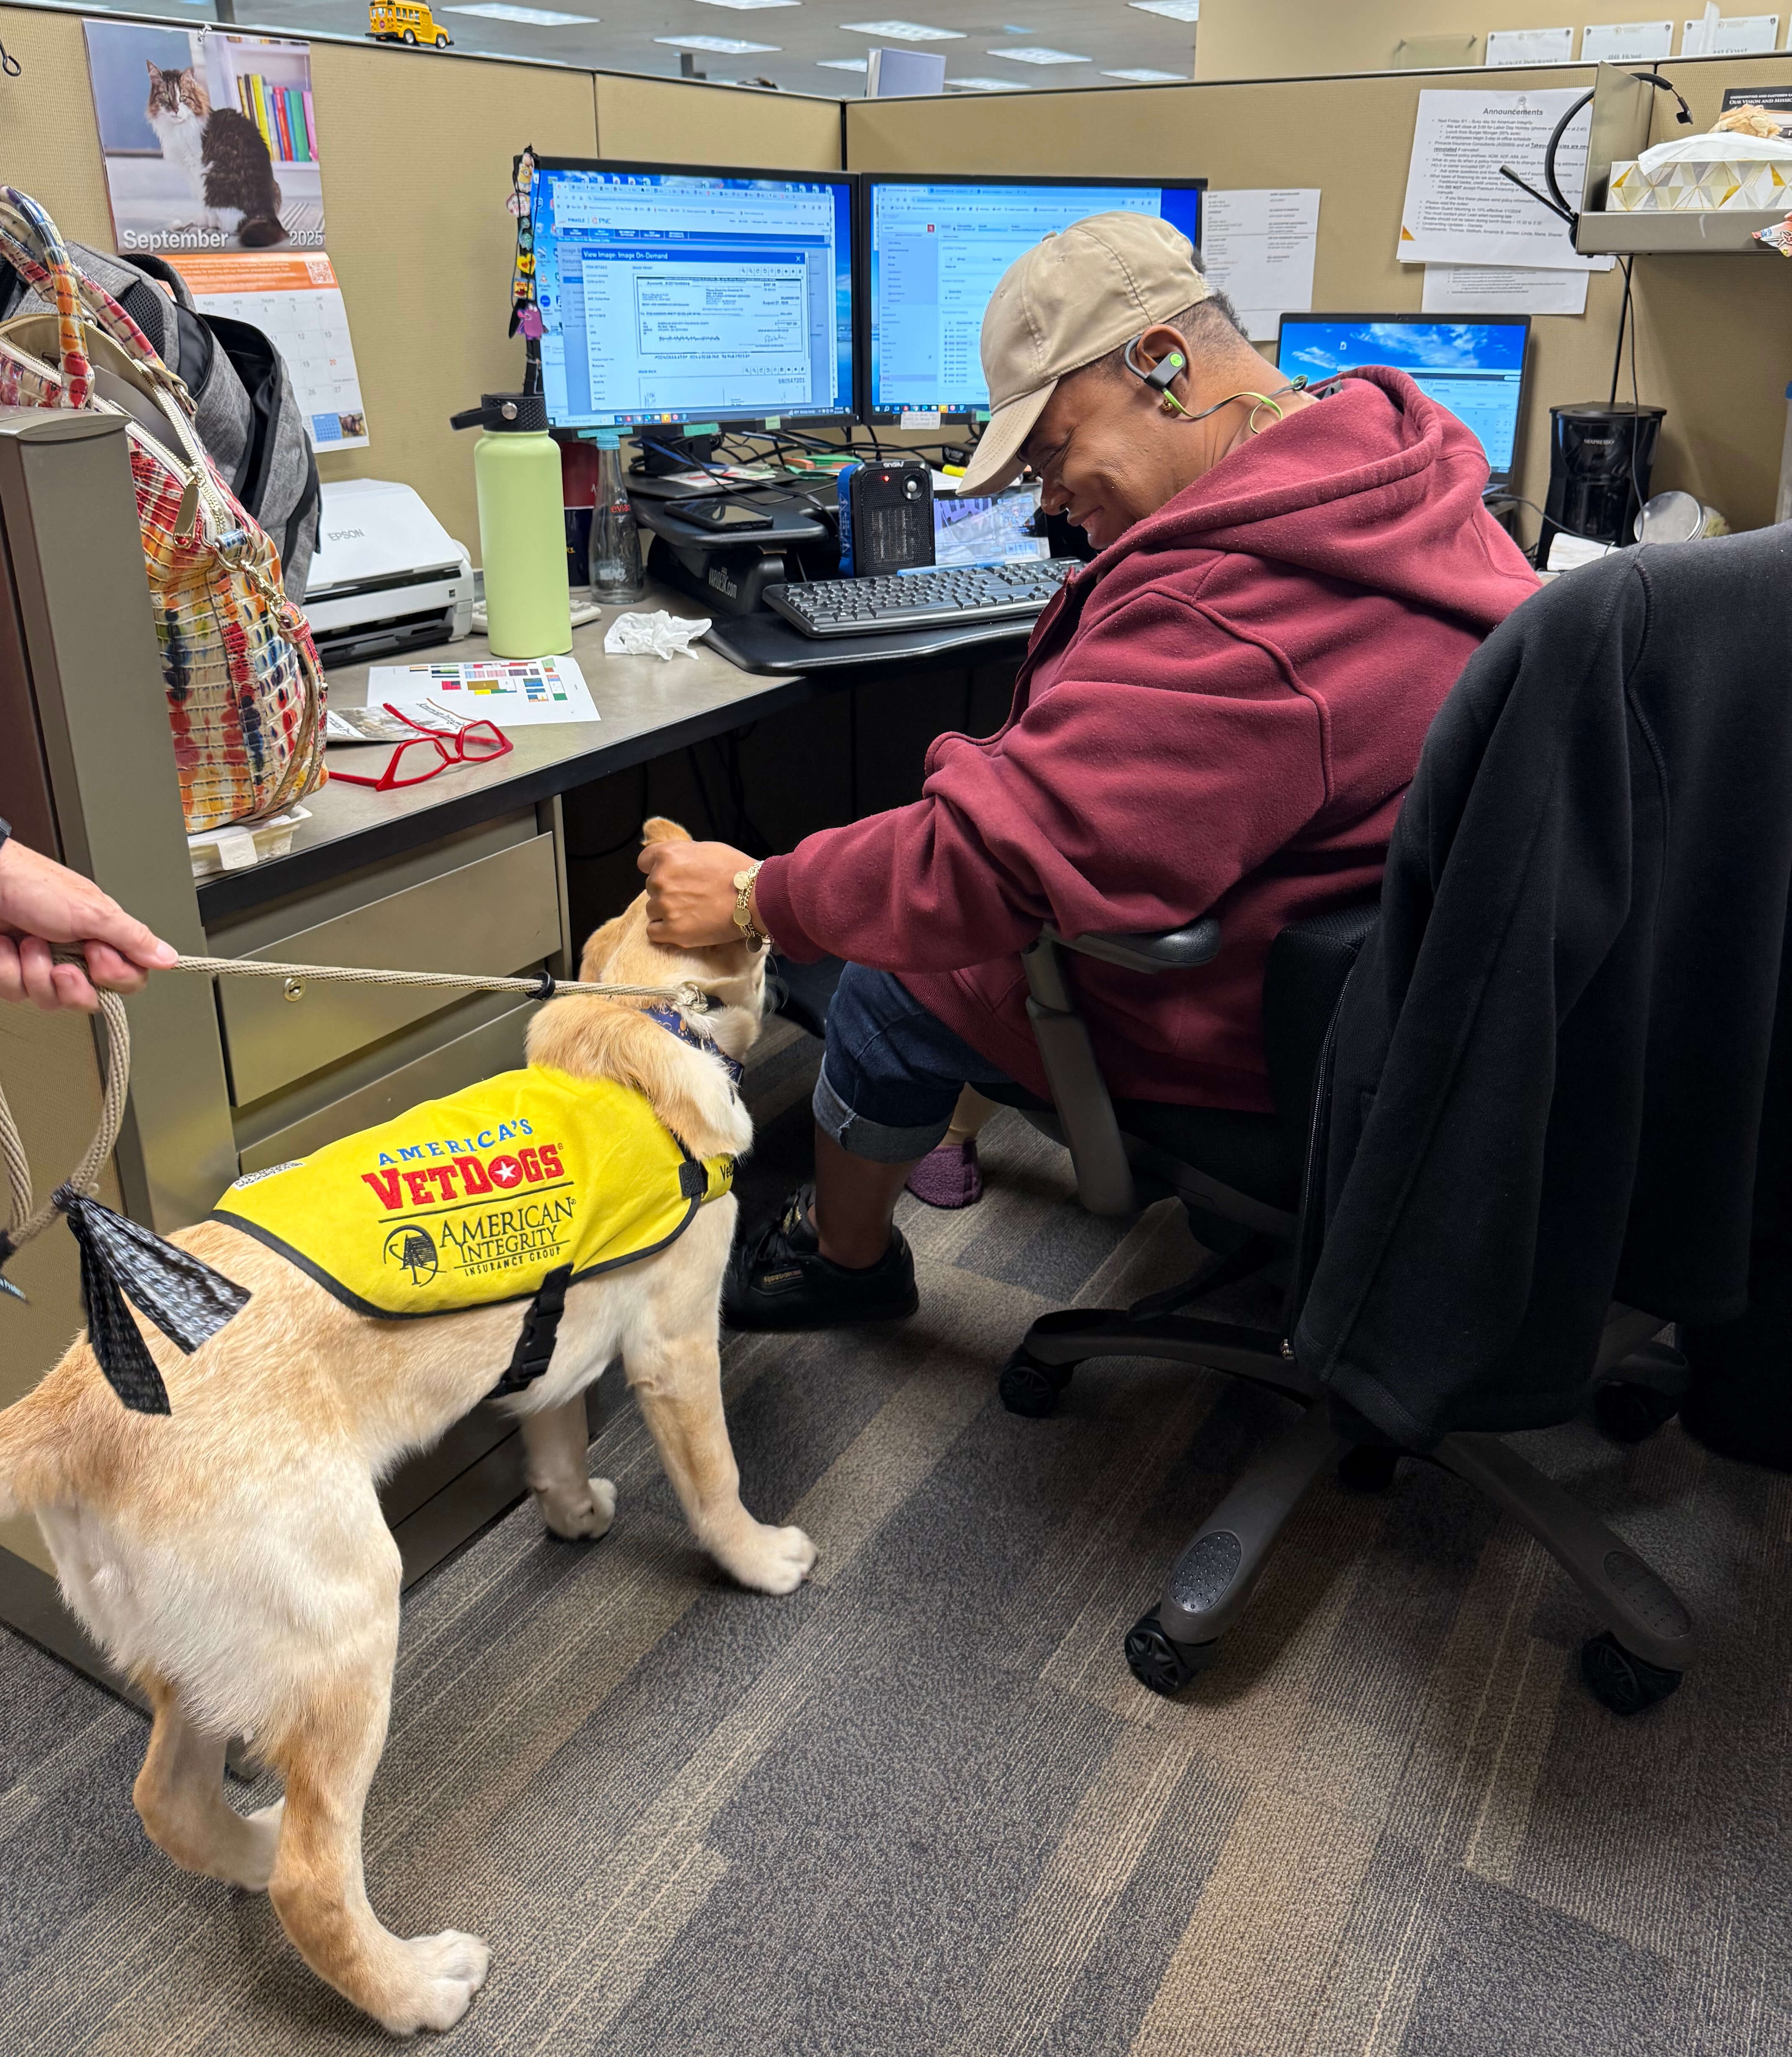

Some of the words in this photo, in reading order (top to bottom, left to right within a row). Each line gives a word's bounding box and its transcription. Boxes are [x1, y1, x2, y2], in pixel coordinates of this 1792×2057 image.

[123, 229, 229, 252] September
[289, 230, 325, 247] 2025
[328, 528, 365, 541] EPSON
[709, 567, 738, 599] VARIDESK.com
[379, 1118, 533, 1166] AMERICA'S
[439, 1196, 574, 1249] AMERICAN
[455, 1225, 558, 1264] INTEGRITY
[464, 1260, 524, 1277] INSURANCE
[530, 1246, 561, 1261] GROUP
